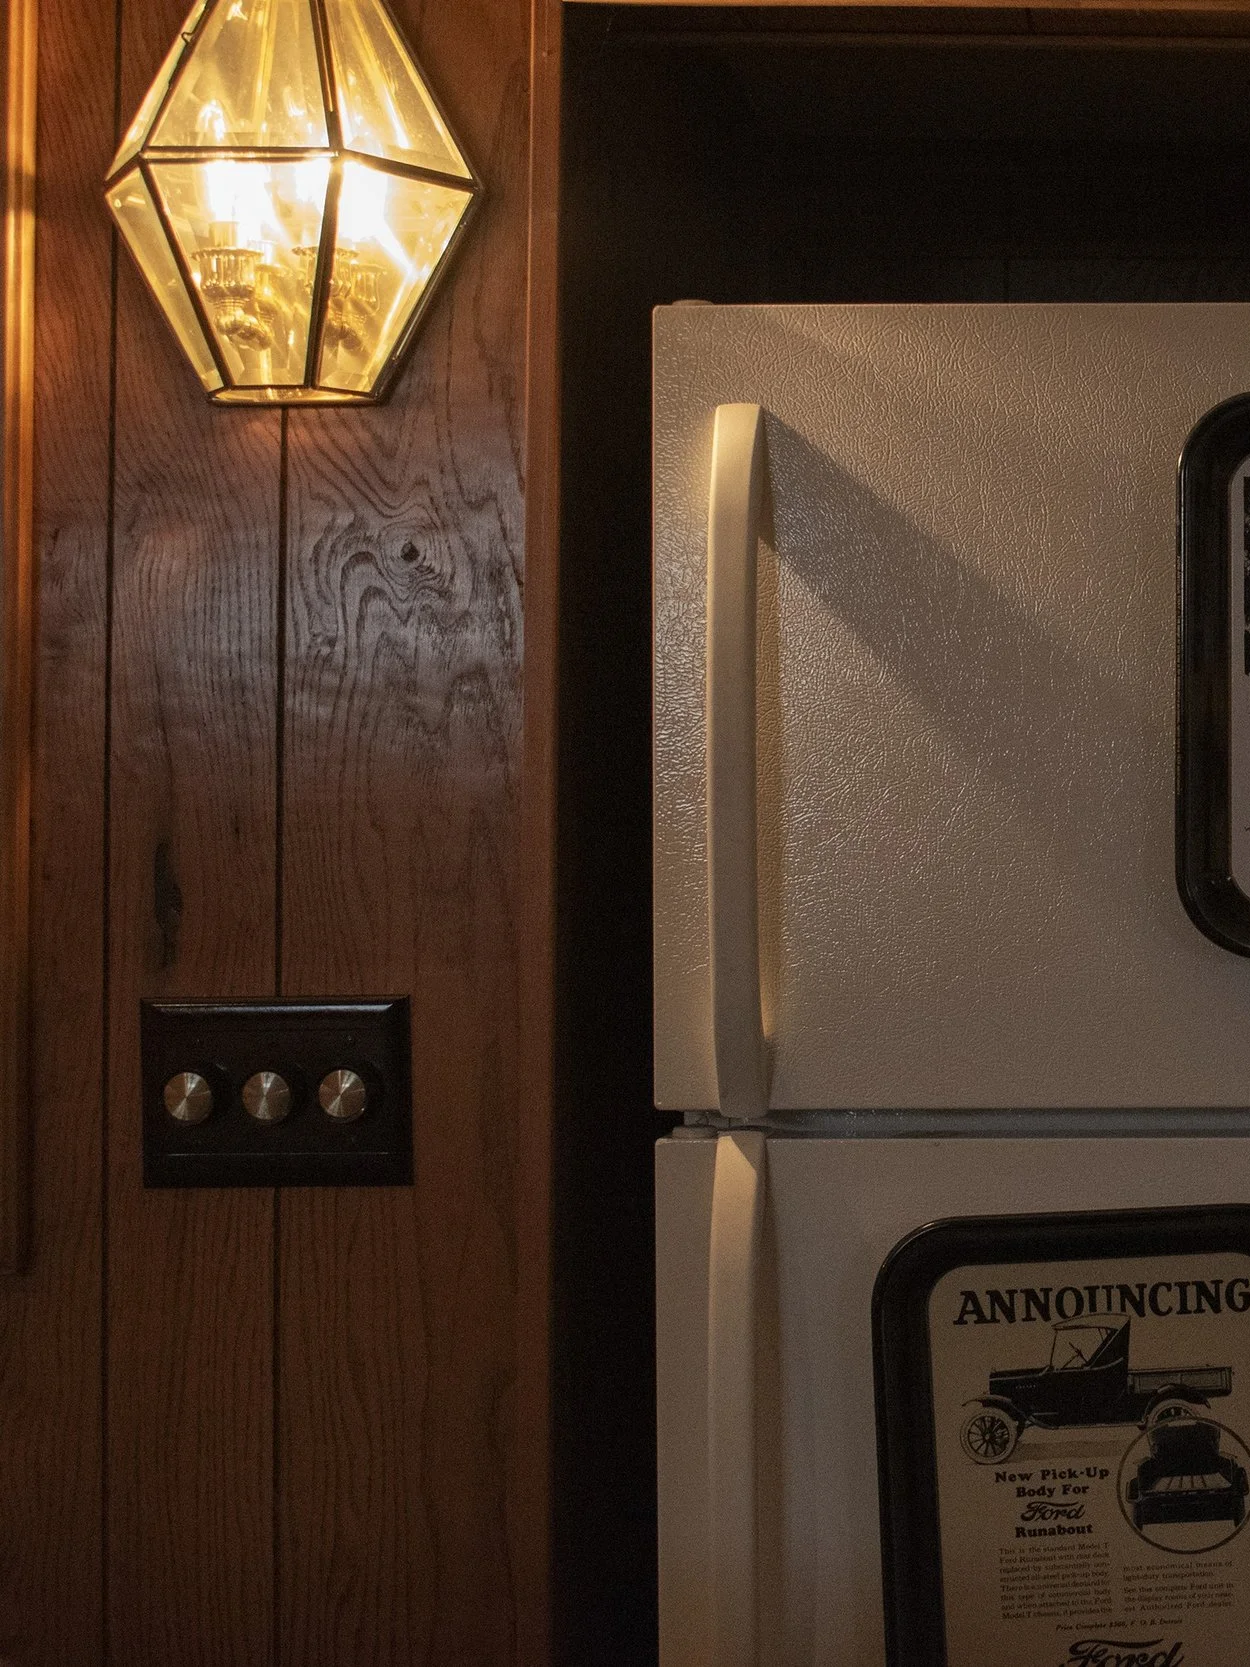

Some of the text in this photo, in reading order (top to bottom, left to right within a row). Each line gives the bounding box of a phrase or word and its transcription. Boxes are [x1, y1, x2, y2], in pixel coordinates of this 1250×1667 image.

[994, 1467, 1110, 1483] New Pick-Up
[1016, 1484, 1090, 1498] Body For
[1020, 1501, 1086, 1521] Ford
[1015, 1524, 1093, 1538] Runabout
[1042, 1544, 1076, 1552] standard
[1019, 1555, 1056, 1563] Runabout
[1146, 1562, 1193, 1571] economical
[1190, 1583, 1207, 1591] Ford
[1140, 1603, 1183, 1611] Authorized
[1058, 1638, 1185, 1667] Ford
